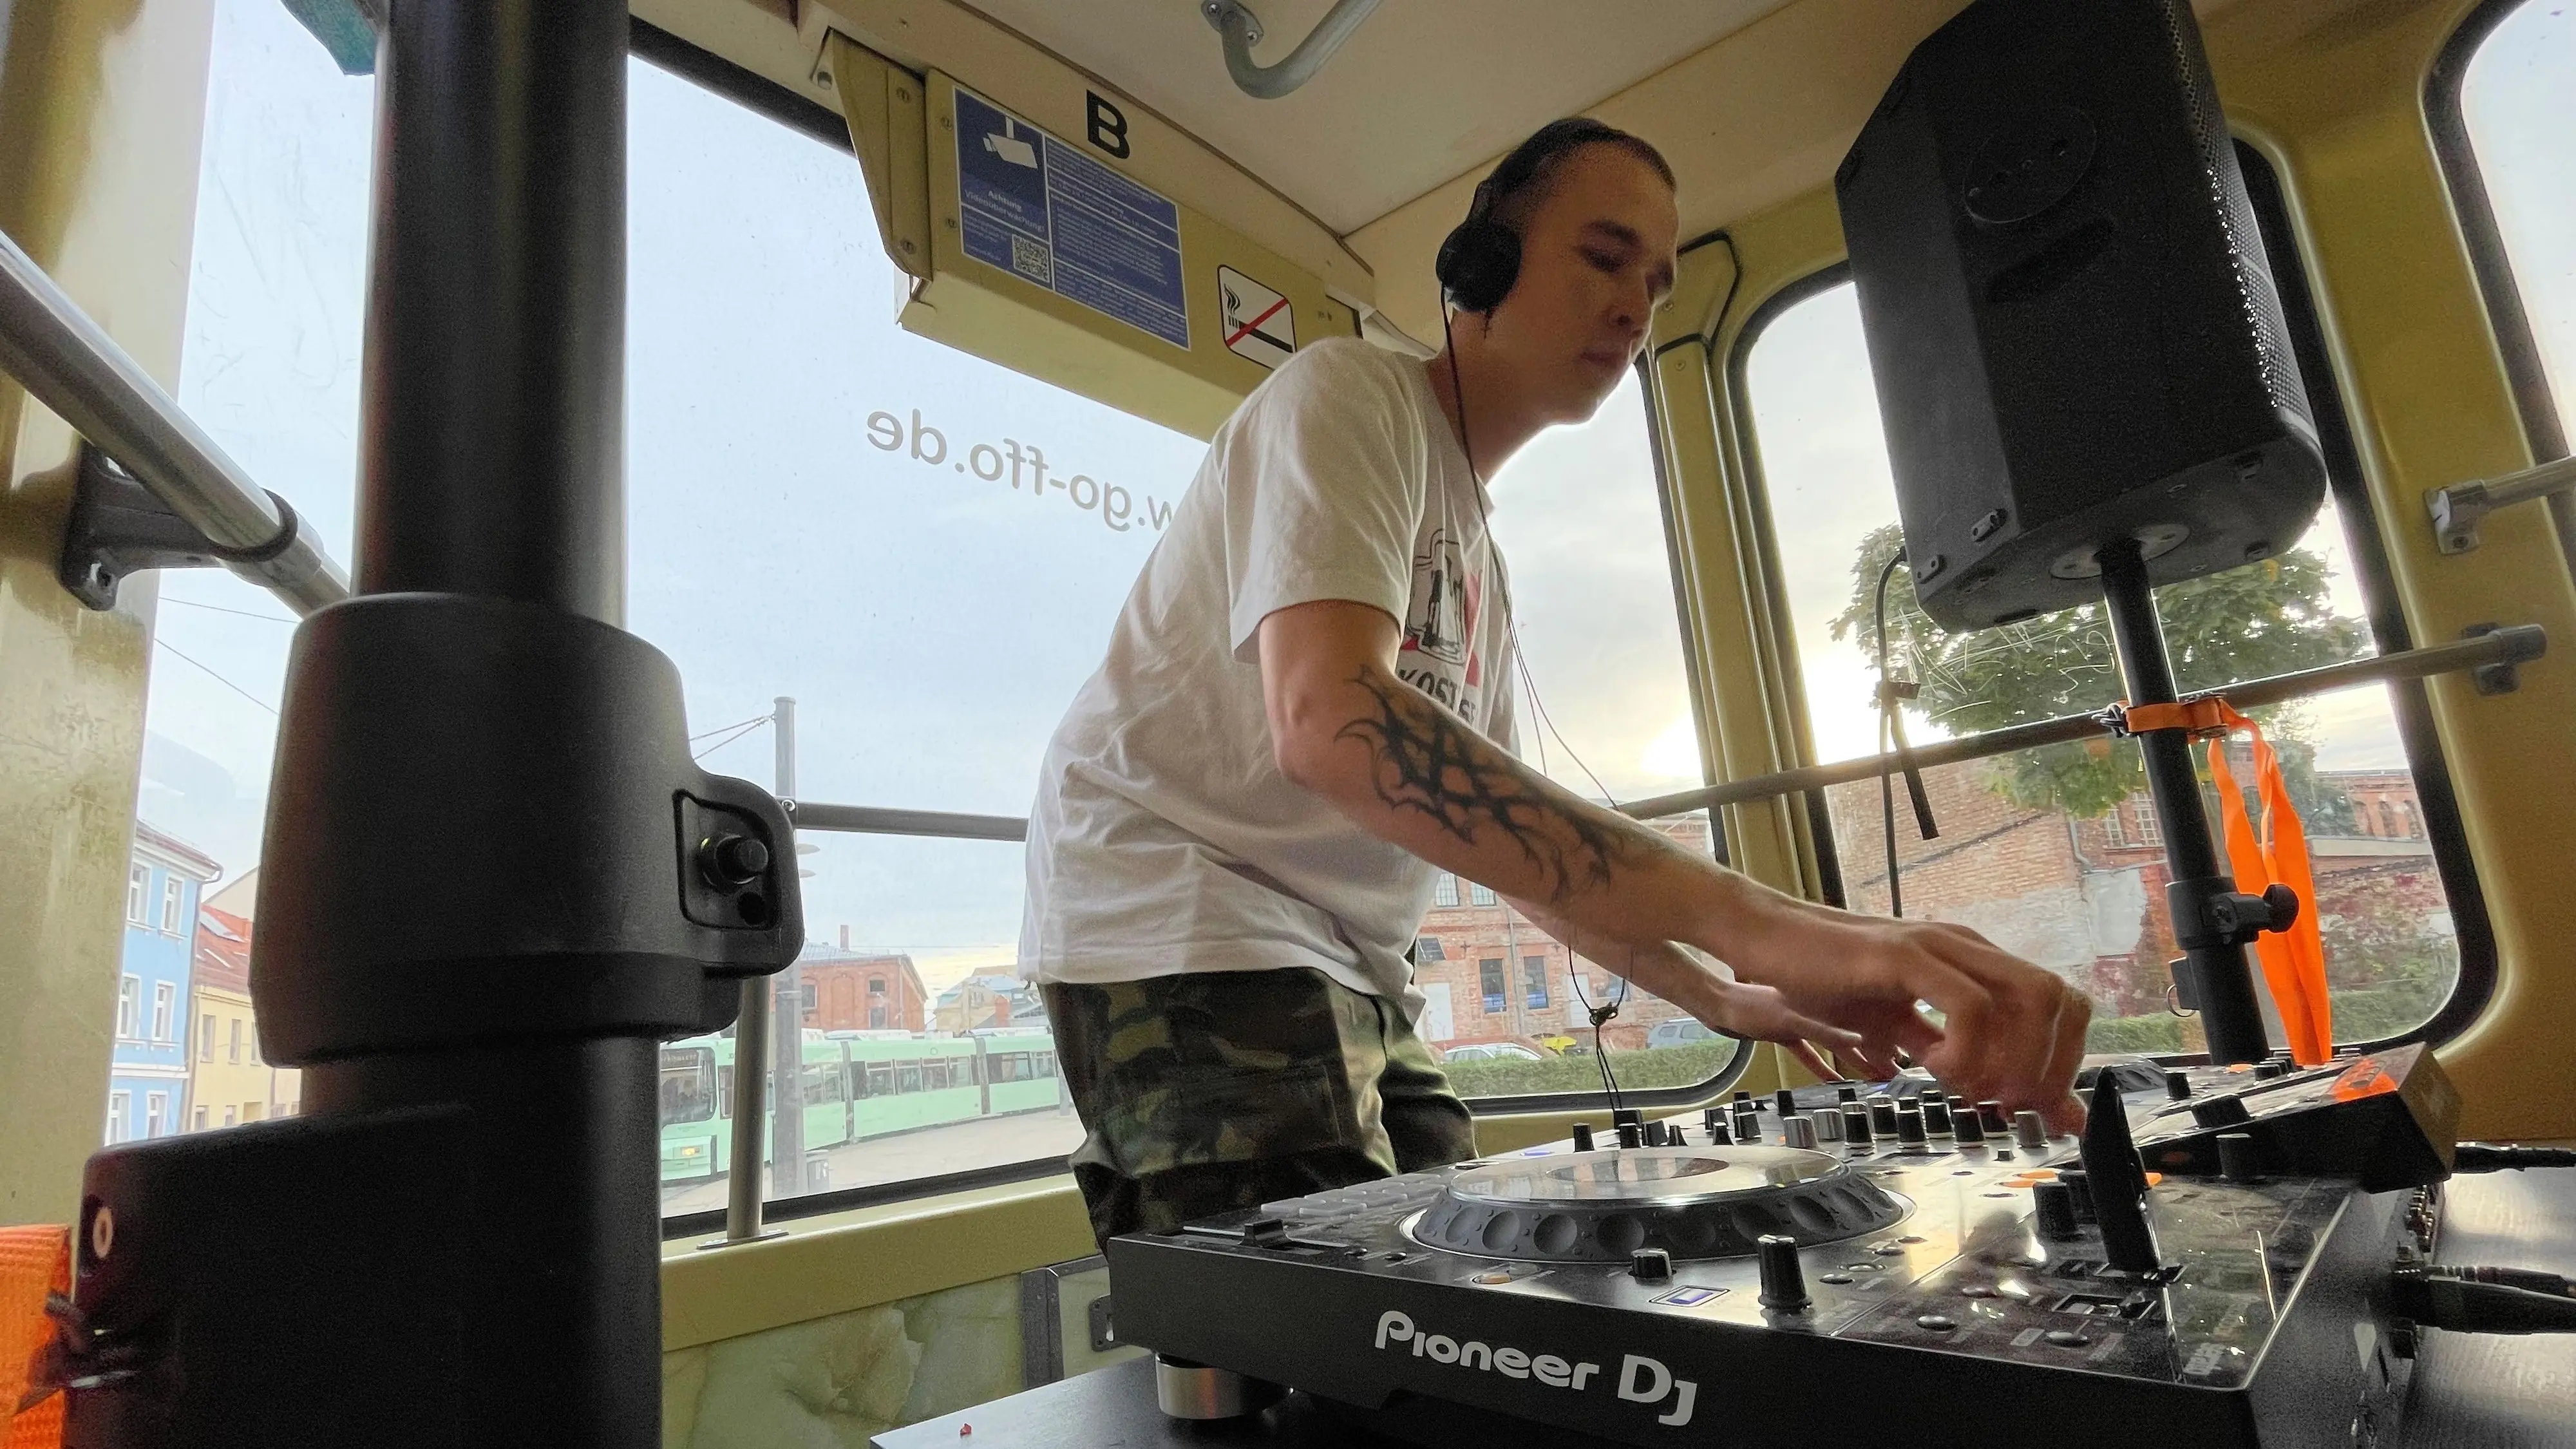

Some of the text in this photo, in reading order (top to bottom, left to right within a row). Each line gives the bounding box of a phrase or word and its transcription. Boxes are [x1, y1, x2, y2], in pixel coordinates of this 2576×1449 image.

[1086, 89, 1130, 159] B
[988, 190, 1022, 213] Achtung
[1375, 1311, 1698, 1426] Pioneer DJ
